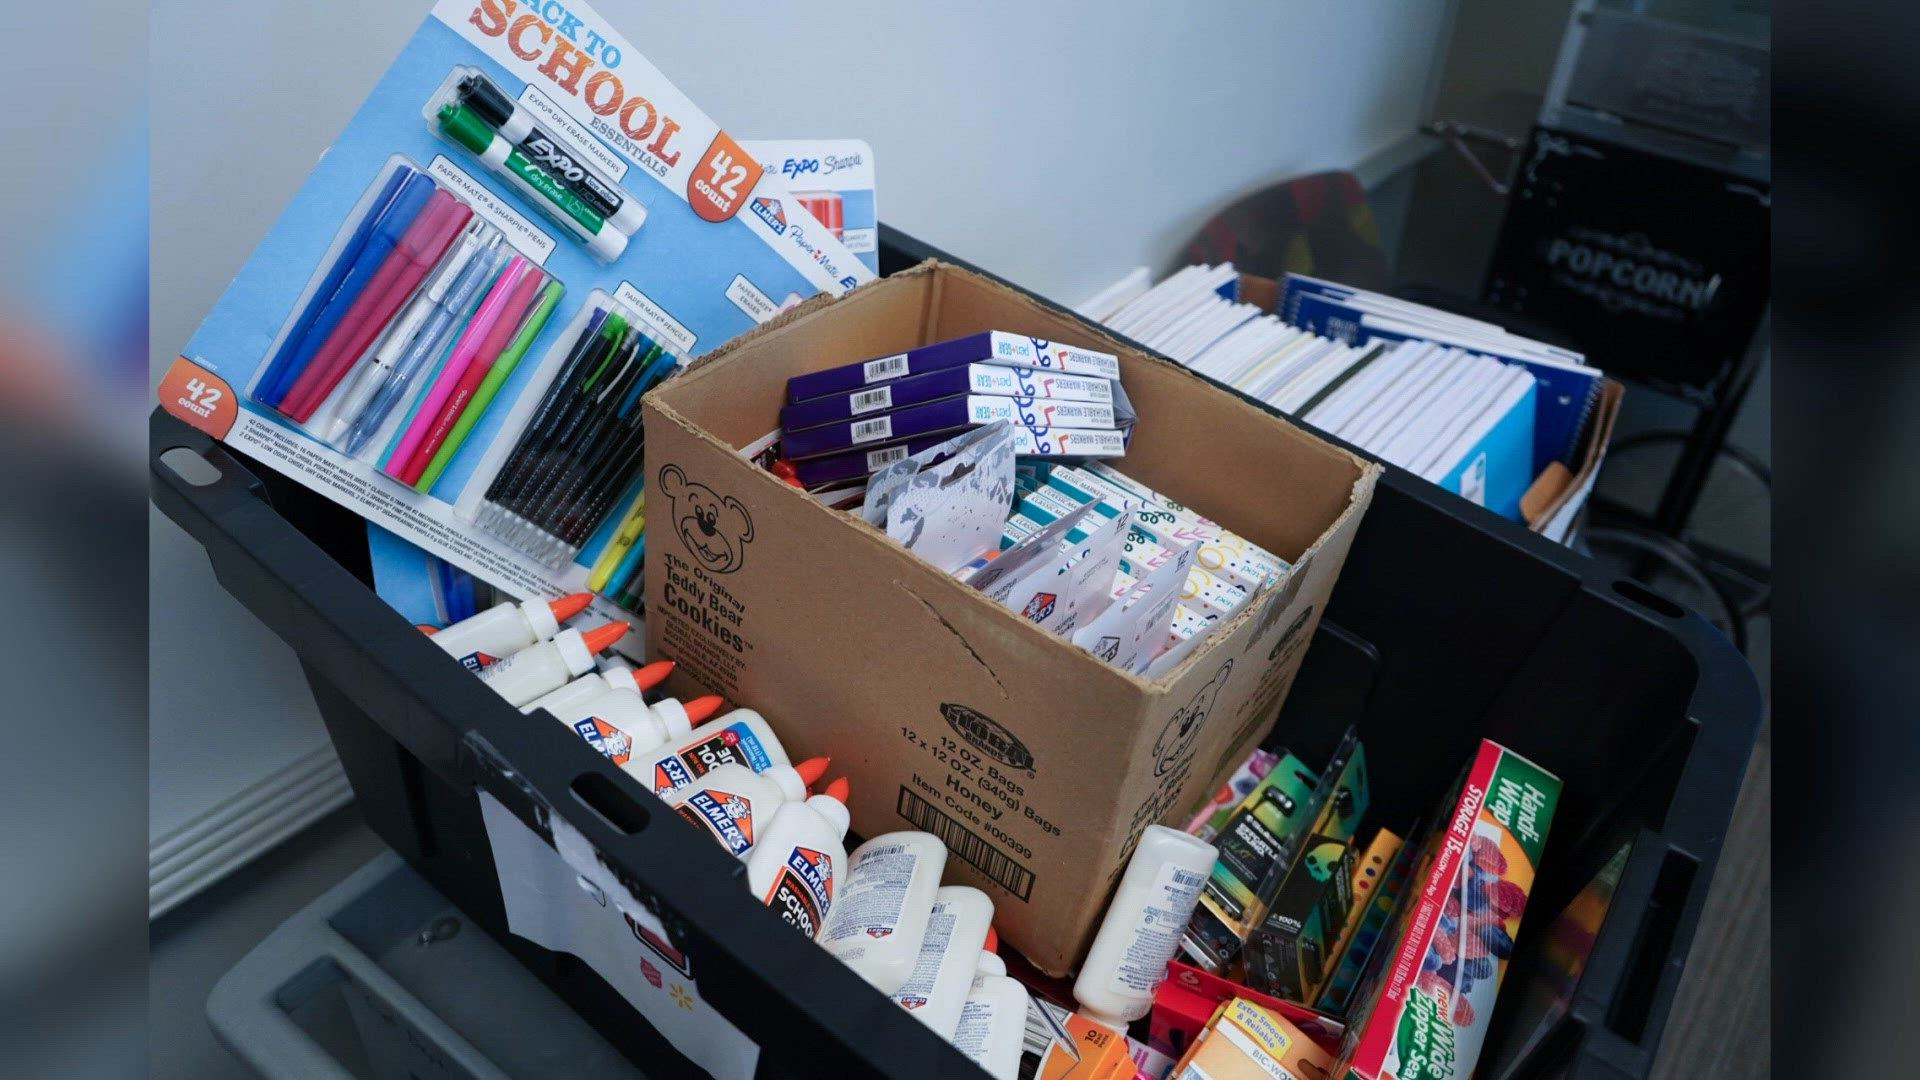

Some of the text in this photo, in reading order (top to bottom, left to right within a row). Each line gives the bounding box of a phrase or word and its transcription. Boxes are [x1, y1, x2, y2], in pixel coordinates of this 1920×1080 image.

[584, 30, 621, 69] TO
[469, 0, 680, 168] SCHOOL
[527, 138, 585, 182] EXPO
[551, 113, 567, 130] DRY
[566, 126, 588, 147] ERASE
[588, 144, 621, 174] MARKERS
[589, 116, 669, 177] ESSENTIALS
[710, 150, 747, 200] 42
[782, 153, 863, 179] EXPO Sharpie
[530, 173, 563, 200] dry erase
[587, 176, 616, 203] low odor
[695, 179, 731, 213] count
[437, 164, 462, 187] PAPER
[487, 202, 494, 210] &
[528, 231, 546, 249] PENS
[752, 202, 786, 233] ELMER'S
[790, 225, 816, 254] Paper
[817, 254, 839, 279] Mate
[737, 283, 755, 301] PAPER
[739, 296, 761, 315] ERASER
[625, 291, 646, 310] PAPER
[663, 320, 688, 343] PENCILS
[999, 342, 1029, 357] pen+GEAR
[1069, 351, 1116, 368] WASHABLE MARKERS
[186, 378, 222, 411] 42
[977, 374, 1011, 388] pen+GEAR
[1056, 378, 1109, 391] WASHABLE MARKERS
[178, 397, 211, 419] count
[975, 405, 1011, 417] pen+GEAR
[1057, 406, 1111, 416] WASHABLE MARKERS
[1069, 433, 1120, 444] WASHABLE MARKERS
[255, 421, 274, 435] COUNT
[305, 449, 323, 462] PAPER
[338, 468, 354, 479] WRITE
[370, 485, 390, 499] CLASSIC
[260, 442, 273, 452] LOW
[272, 449, 288, 460] ODOR
[286, 457, 304, 470] CHISEL
[304, 467, 316, 476] DRY
[315, 473, 332, 484] ERASE
[272, 440, 296, 456] NARROW
[294, 453, 313, 465] CHISEL
[312, 462, 332, 476] POCKET
[1043, 489, 1066, 504] CLASSIC
[1056, 470, 1081, 486] CLASSIC
[1031, 496, 1054, 512] CLASSIC
[665, 553, 745, 613] The Original
[665, 563, 743, 627] Teddy Bear
[964, 732, 1004, 762] BRANDS
[901, 727, 1061, 836] 12 x 12 OZ. (340g) Bags
[941, 736, 1024, 796] 12 OZ. Bags
[945, 774, 1003, 820] Honey
[1452, 784, 1483, 837] STORAGE
[1488, 777, 1522, 828] Wrap
[1517, 782, 1546, 843] Handi-
[692, 793, 748, 850] ELMER'S
[912, 773, 1032, 860] Item Code #00399
[1438, 851, 1451, 874] GALLON
[1447, 838, 1464, 855] 15
[1085, 1029, 1097, 1041] 10
[1237, 1001, 1286, 1048] Extra Smooth
[1245, 1018, 1275, 1048] Reliable
[1409, 989, 1437, 1051] Zipper
[1427, 1024, 1455, 1079] Wide
